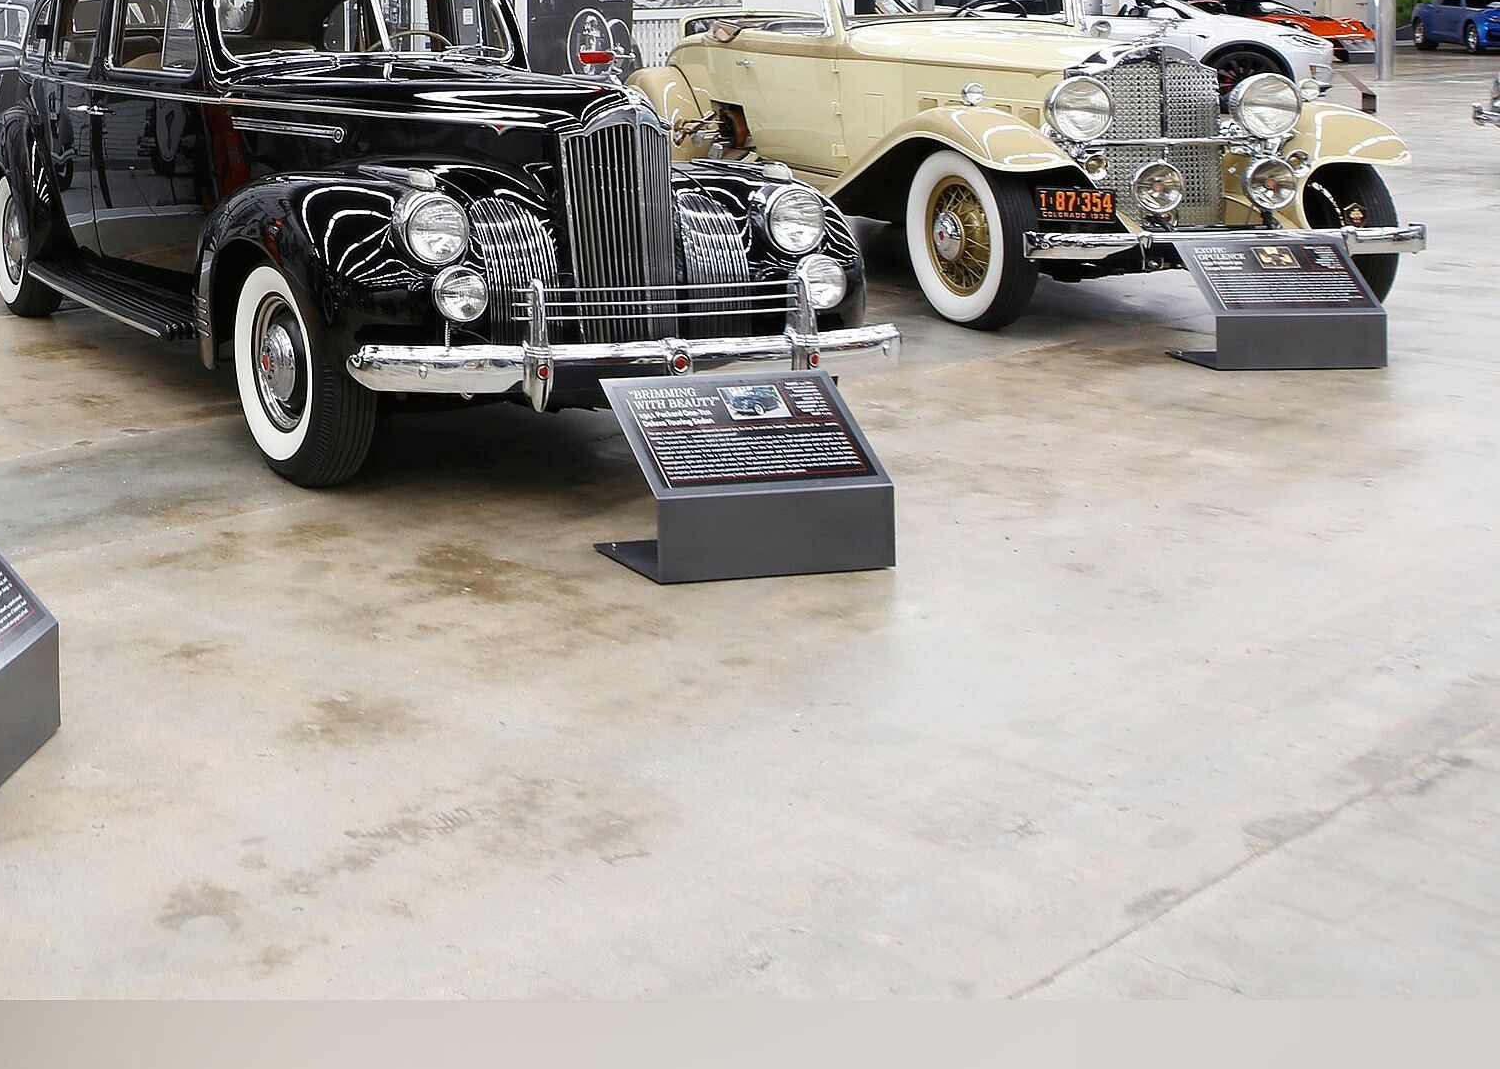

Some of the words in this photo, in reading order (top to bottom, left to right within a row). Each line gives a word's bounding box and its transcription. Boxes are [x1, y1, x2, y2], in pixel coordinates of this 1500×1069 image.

[1042, 211, 1087, 219] COLORADO
[628, 387, 697, 400] "BRIMMING
[633, 399, 667, 410] WITH
[668, 396, 720, 409] BEAUTY"
[655, 410, 683, 419] Packard
[665, 418, 694, 427] Touring
[691, 417, 716, 425] Sedan
